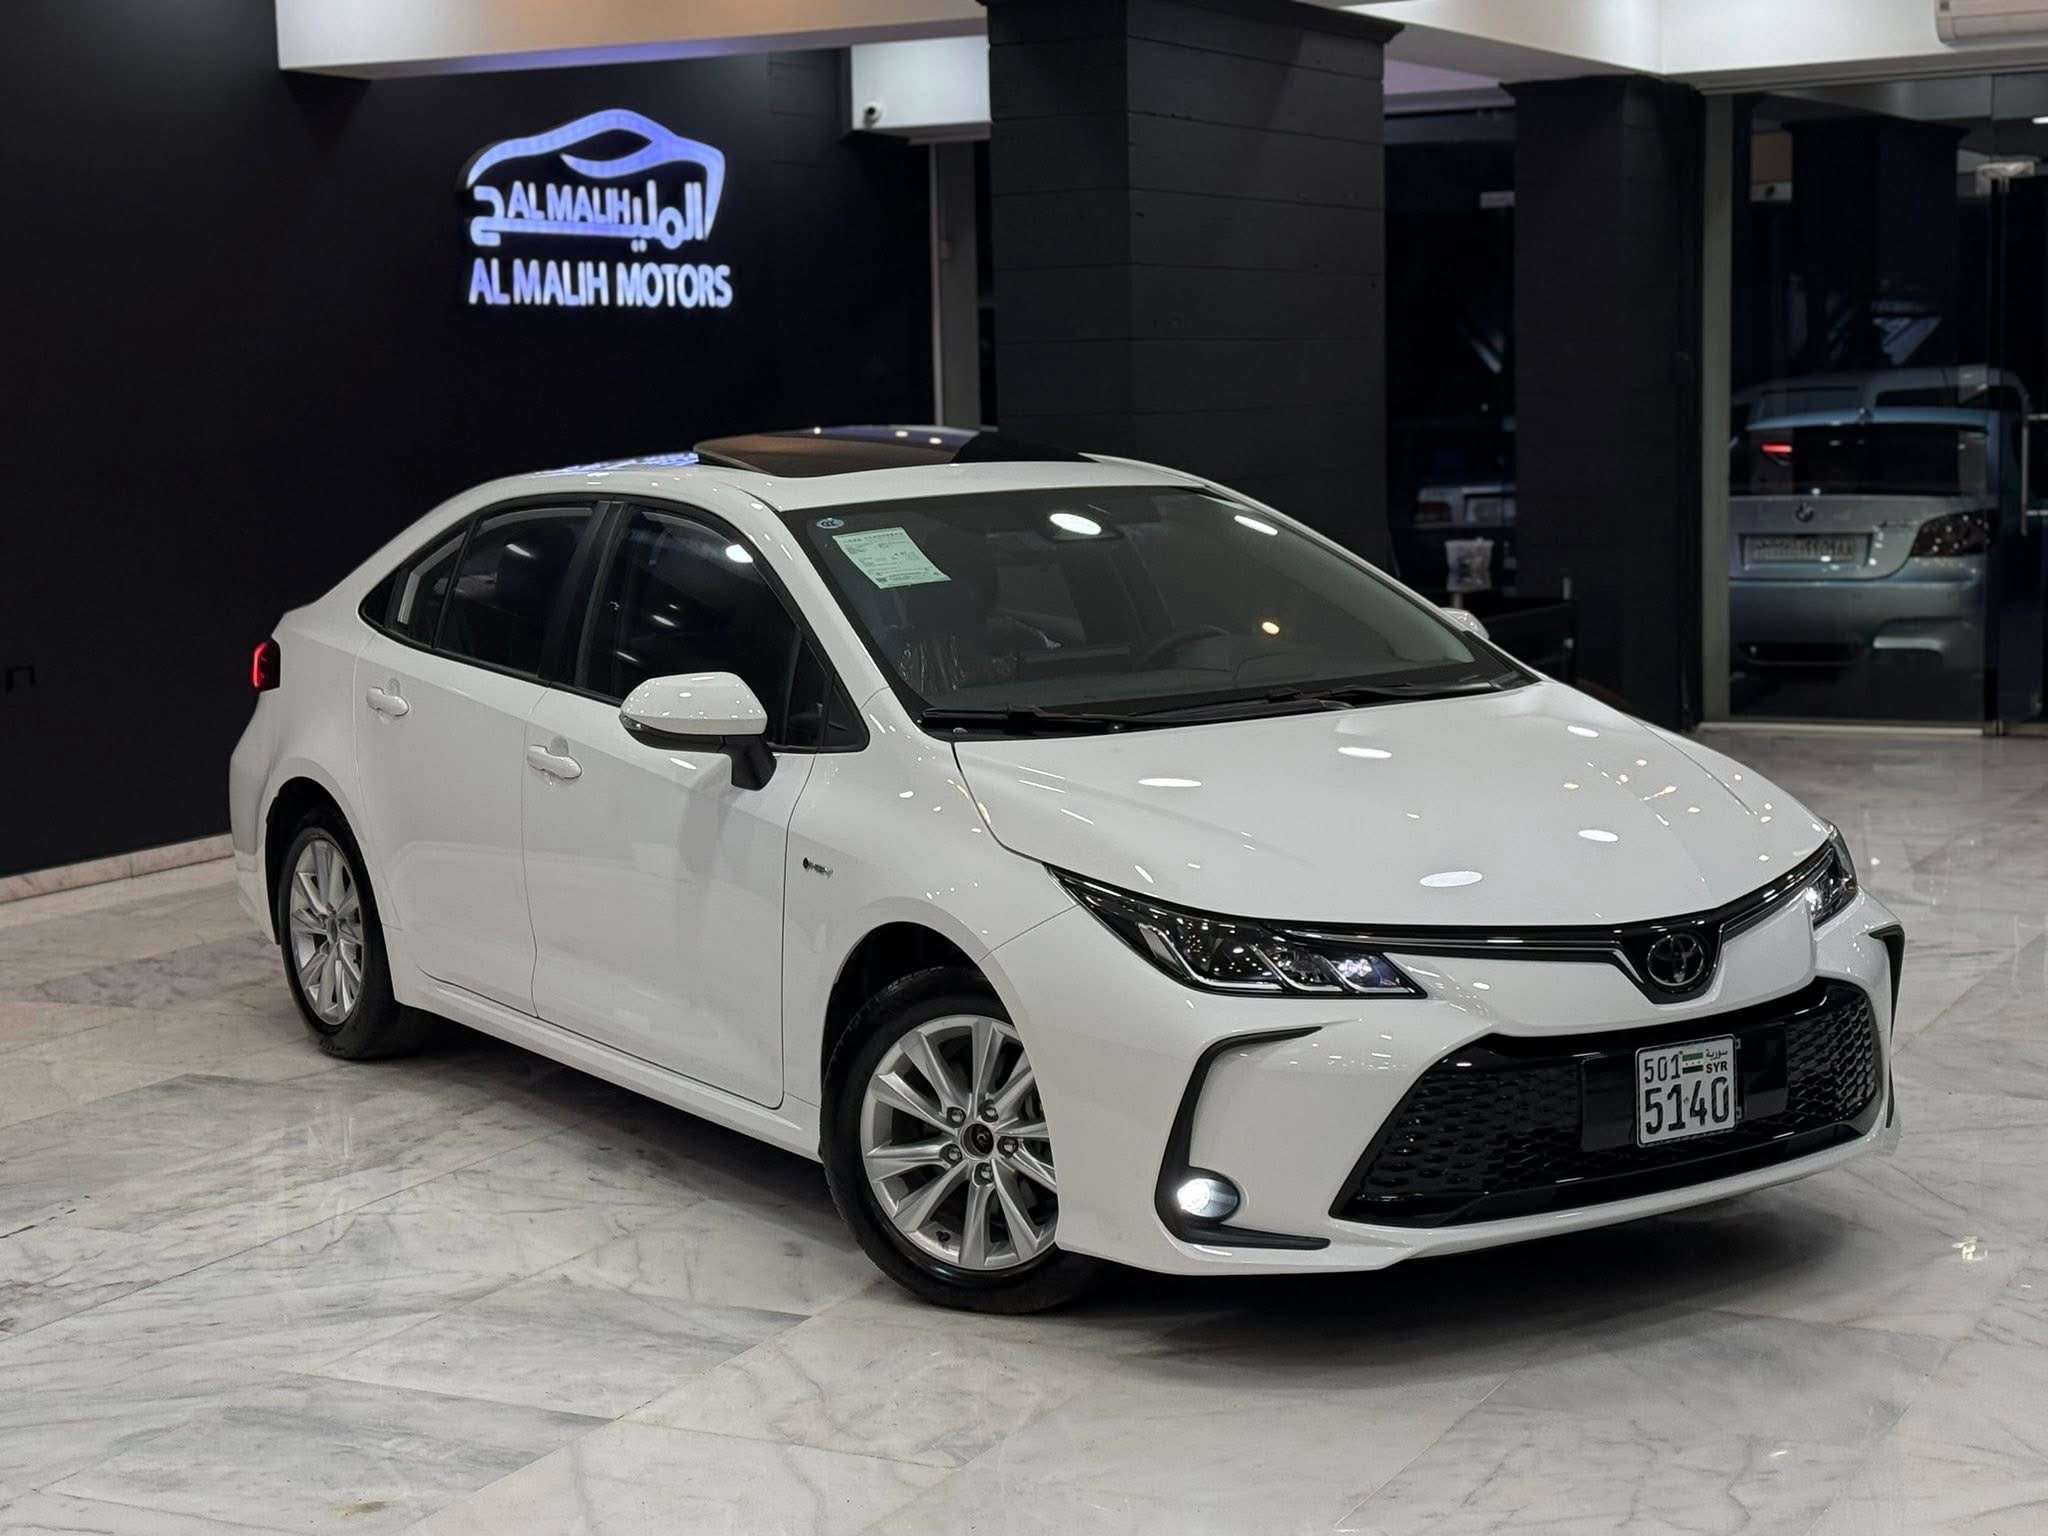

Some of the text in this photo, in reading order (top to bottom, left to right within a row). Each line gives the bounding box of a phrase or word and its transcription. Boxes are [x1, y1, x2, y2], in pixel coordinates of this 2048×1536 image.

[470, 179, 704, 252] المليح
[507, 180, 630, 224] AL MALIH
[468, 257, 733, 308] AL MALIH MOTORS
[1644, 1054, 1680, 1084] 501
[1706, 1061, 1728, 1074] SYR
[1645, 1076, 1730, 1135] 5140
